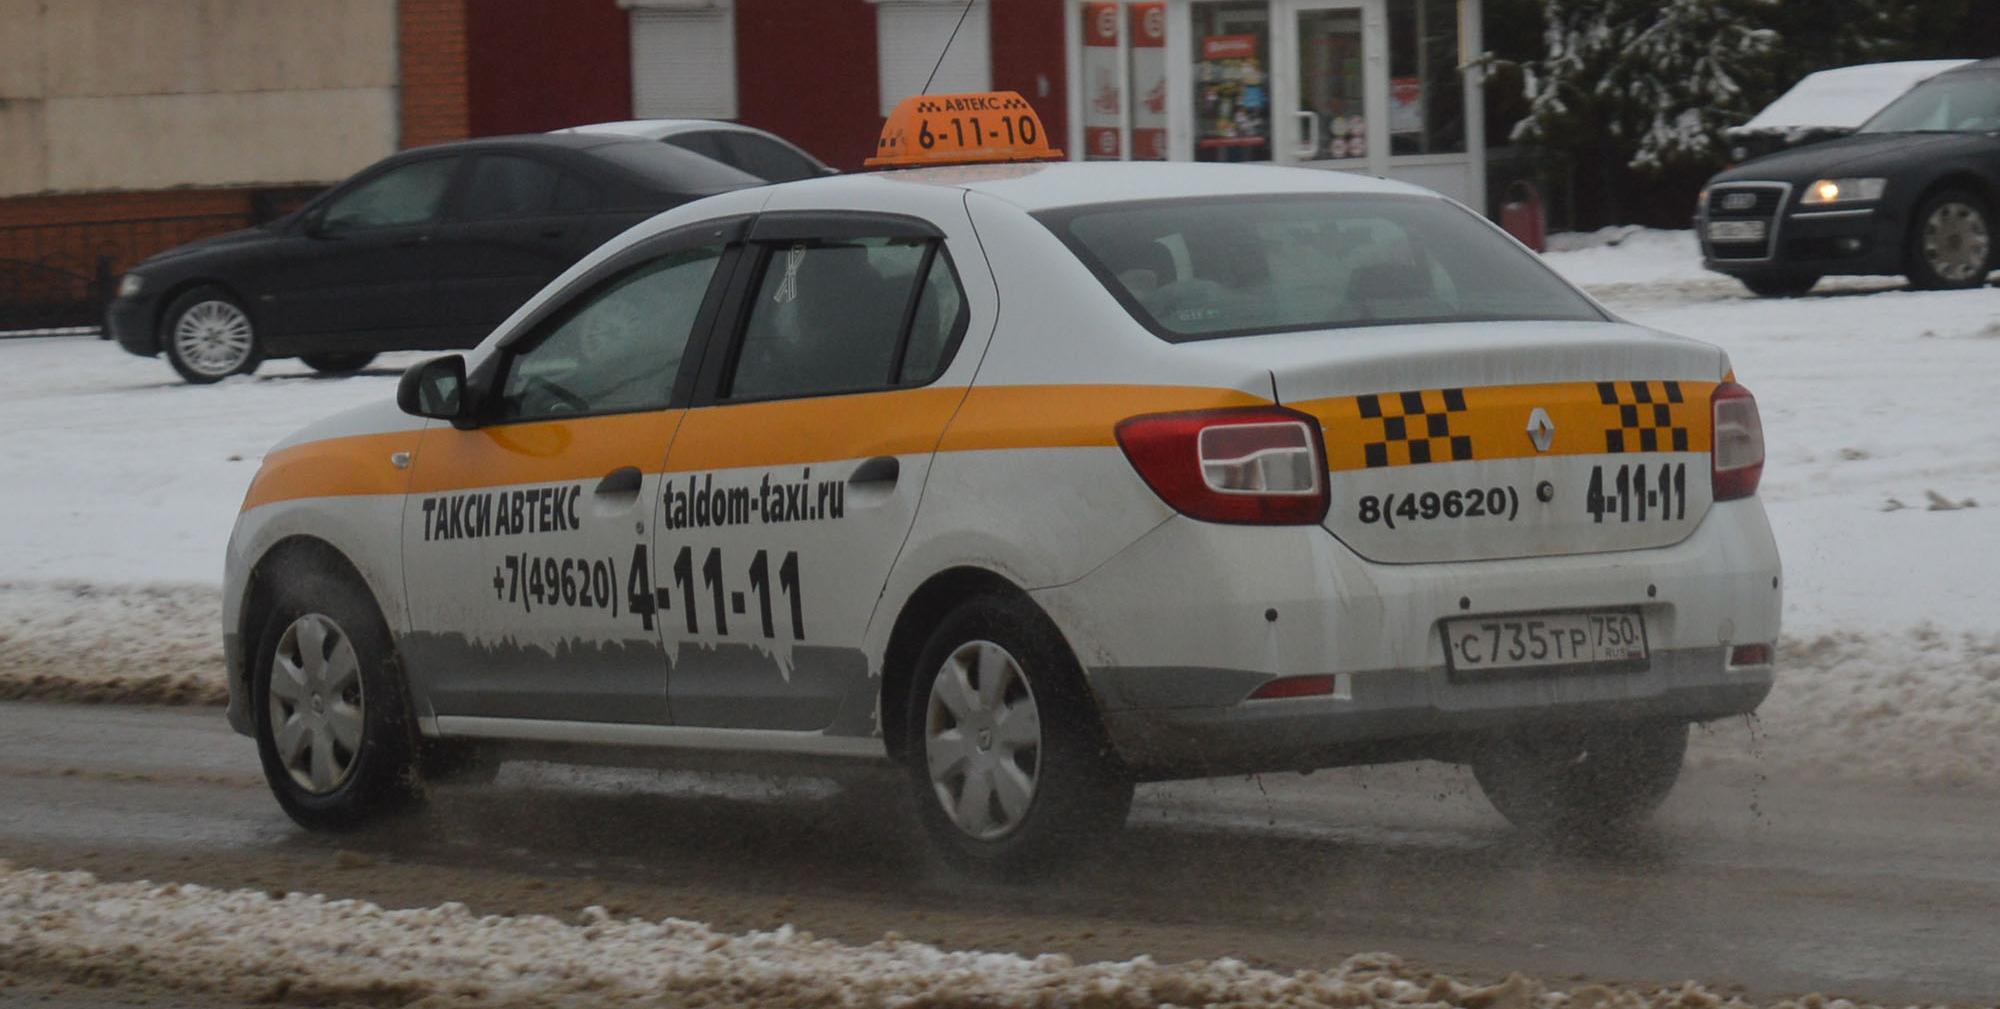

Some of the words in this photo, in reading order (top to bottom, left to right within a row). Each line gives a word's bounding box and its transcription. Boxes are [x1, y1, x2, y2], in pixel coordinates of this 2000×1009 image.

[945, 97, 1001, 112] АВТЕКС
[918, 115, 1037, 150] 6-11-10
[422, 493, 492, 541] ТАКСИ
[494, 485, 582, 535] АВТЕКС
[663, 467, 845, 530] taldom-taxi.ru
[1357, 486, 1520, 529] 8(49620)
[1586, 462, 1686, 523] 4-11-11
[493, 552, 618, 618] +7(49620)
[627, 543, 806, 641] 4-11-11
[1591, 616, 1635, 647] 750
